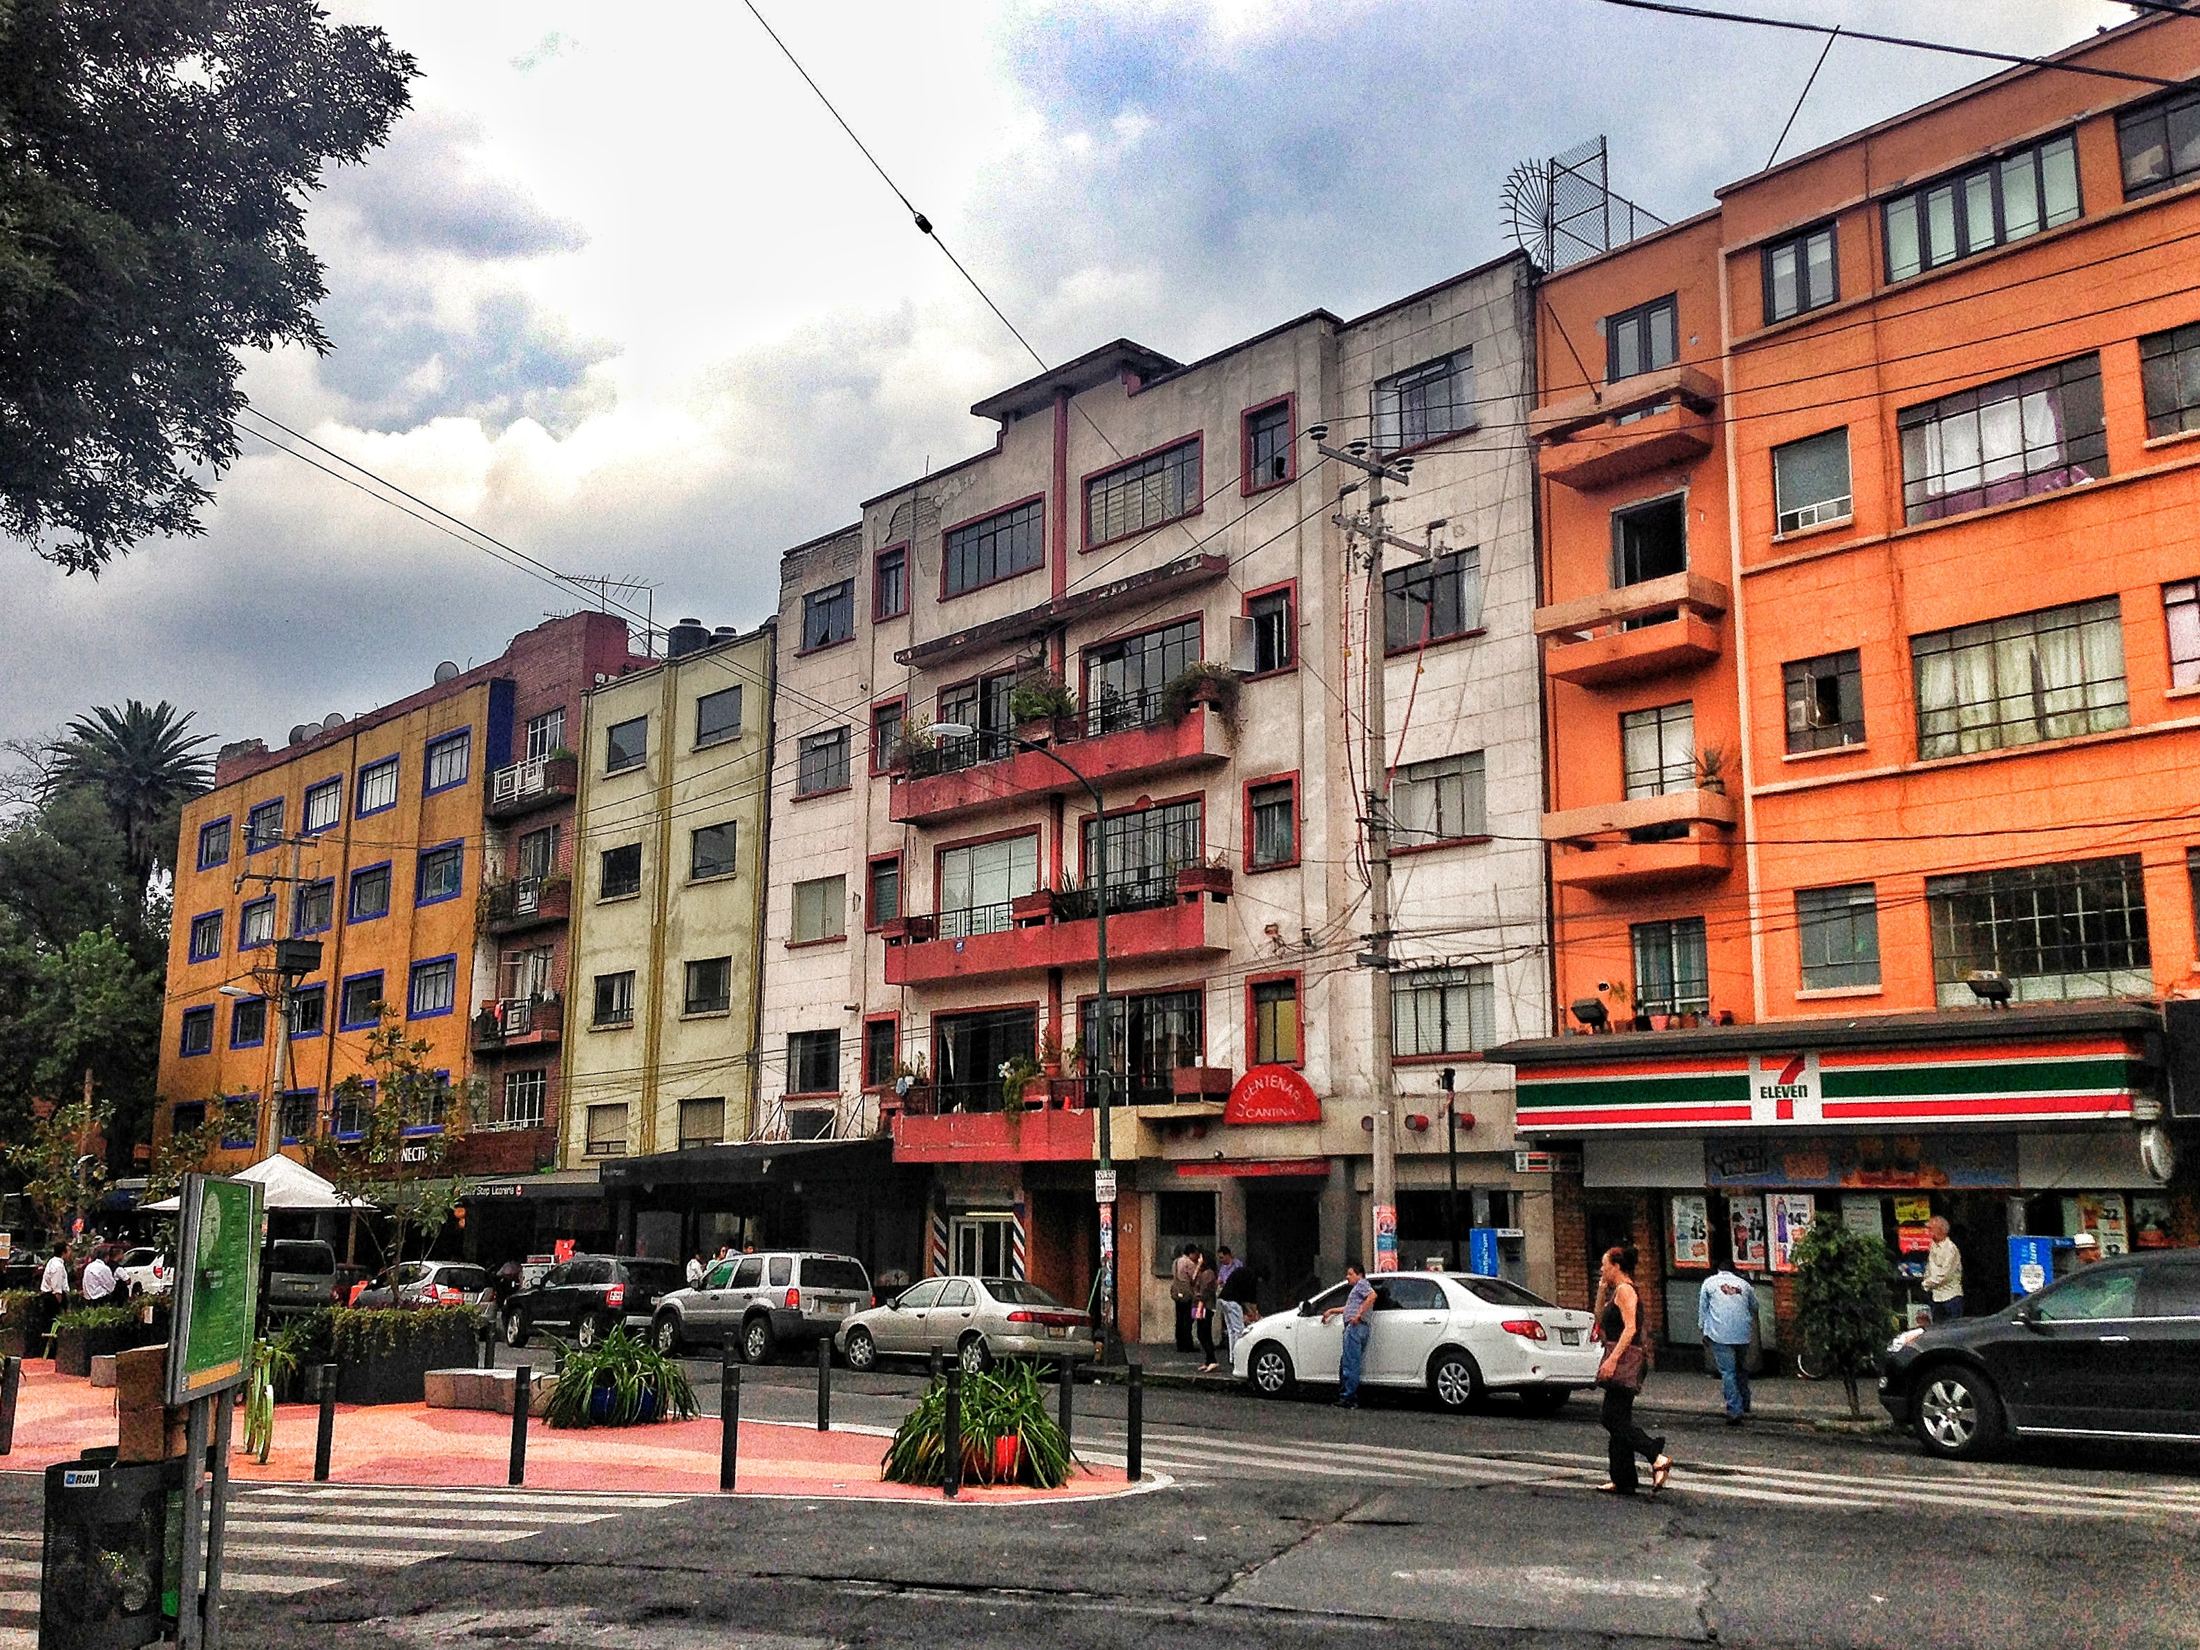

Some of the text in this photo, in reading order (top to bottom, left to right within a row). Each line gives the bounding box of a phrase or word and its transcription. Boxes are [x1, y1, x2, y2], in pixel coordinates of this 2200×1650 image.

[1243, 1074, 1306, 1115] CENTENAR
[1246, 1106, 1297, 1119] CANTINA
[76, 1473, 97, 1484] RUN
